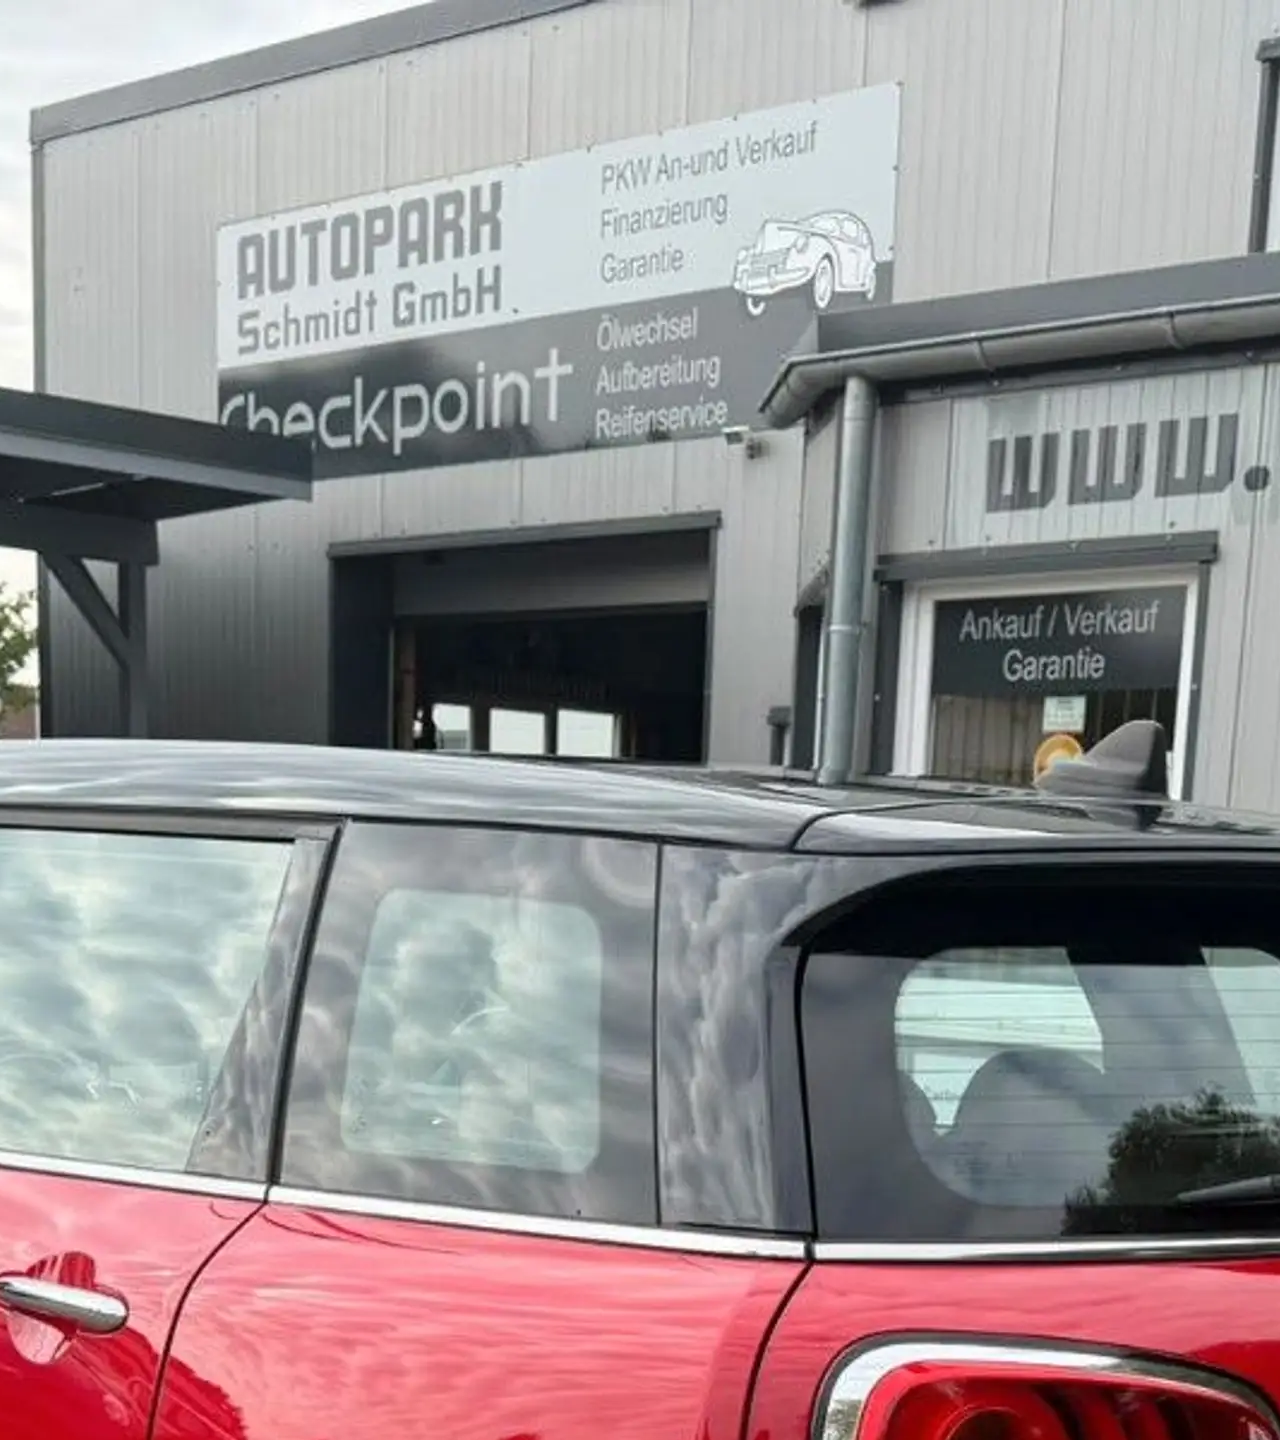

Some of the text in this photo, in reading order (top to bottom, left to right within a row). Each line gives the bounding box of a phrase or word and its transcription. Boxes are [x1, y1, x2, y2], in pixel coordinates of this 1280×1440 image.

[601, 155, 652, 195] PKW
[736, 120, 818, 167] Verkauf
[601, 194, 727, 239] Finanzierung
[237, 180, 503, 300] AUTOPARK
[601, 244, 685, 283] Garantie
[237, 265, 502, 356] Schmidt GmbH
[596, 306, 699, 351] Ölwechsel
[596, 355, 720, 395] Aufbereitung
[596, 395, 728, 440] Reifenservice
[959, 600, 1160, 642] Ankauf / Verkauf
[1002, 647, 1106, 682] Garantie
